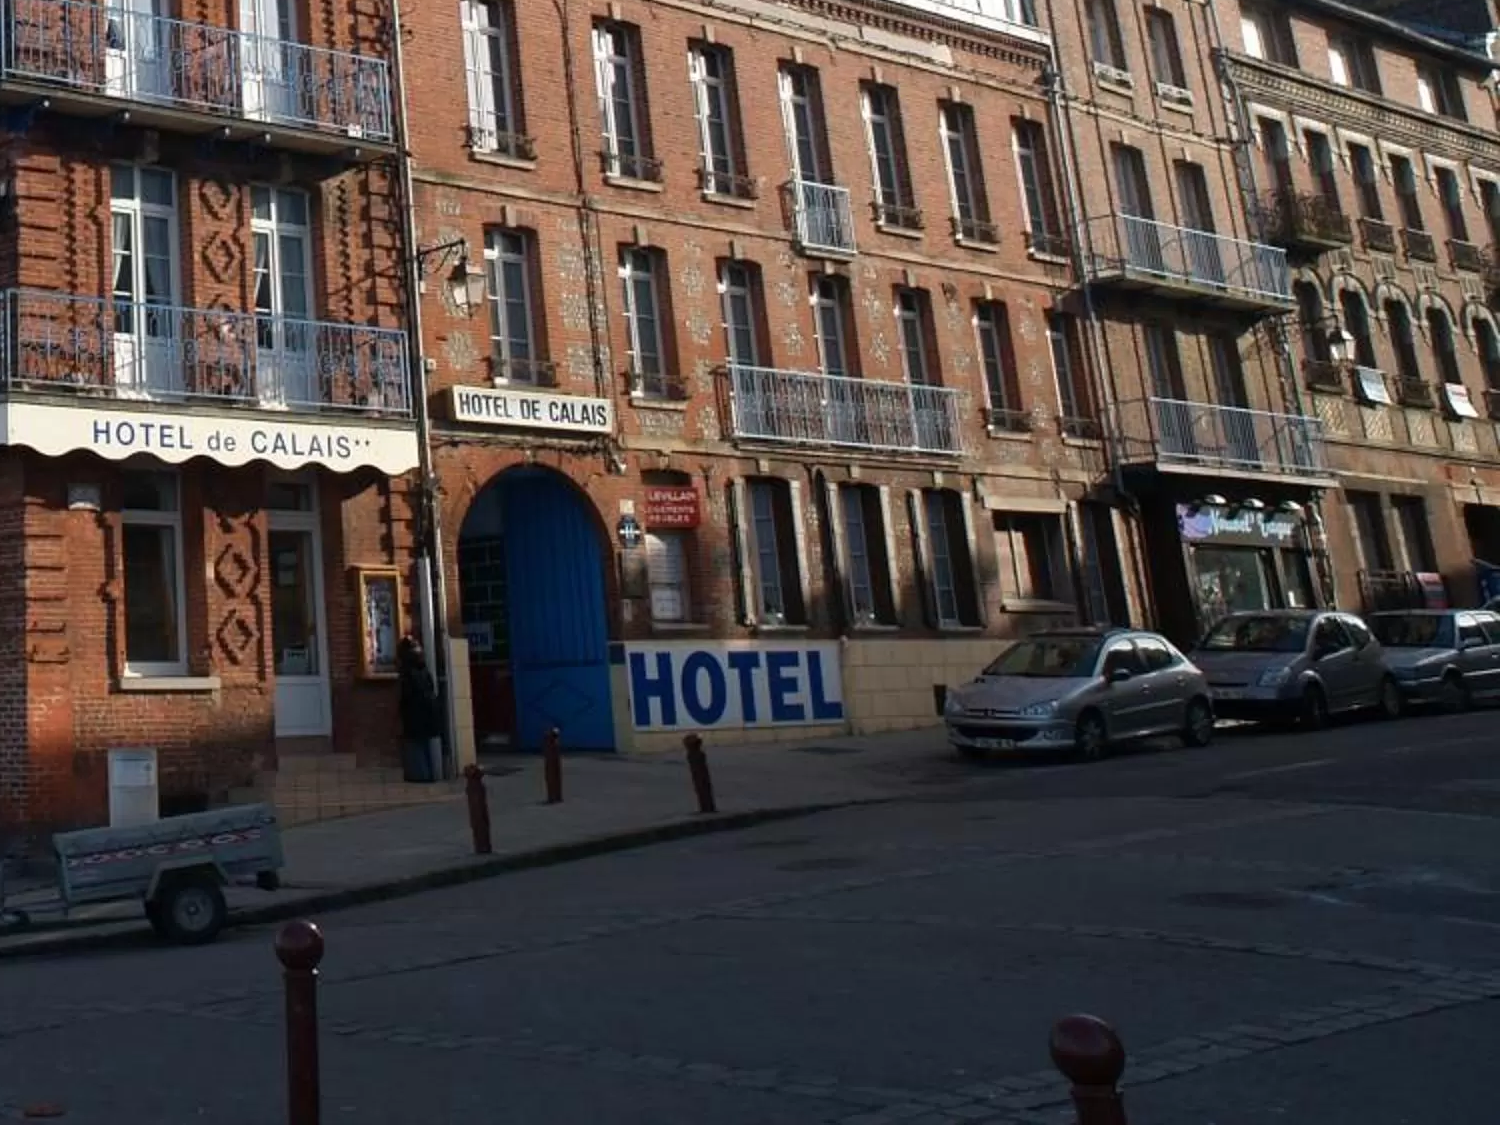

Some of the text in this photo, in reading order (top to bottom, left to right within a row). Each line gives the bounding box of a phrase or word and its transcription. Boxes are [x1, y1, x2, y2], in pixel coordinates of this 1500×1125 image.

[459, 393, 607, 426] HOTEL DE CALAIS
[93, 420, 352, 458] HOTEL de CALAIS
[629, 650, 843, 726] HOTEL
